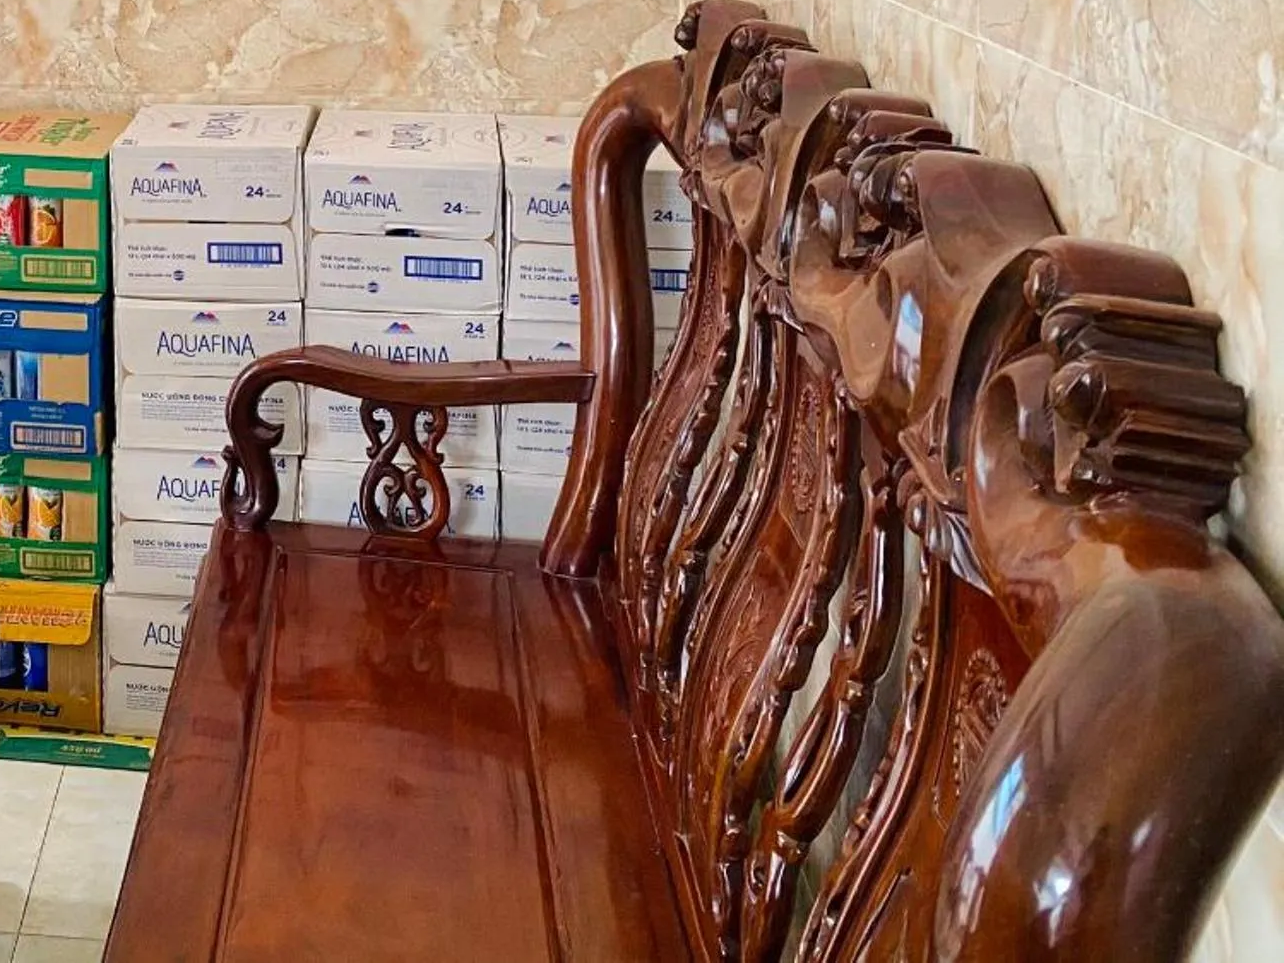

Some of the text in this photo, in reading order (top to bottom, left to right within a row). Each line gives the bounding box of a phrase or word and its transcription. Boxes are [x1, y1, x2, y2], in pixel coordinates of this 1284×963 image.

[130, 176, 204, 197] AQUAFINA
[245, 185, 264, 198] 24
[322, 188, 398, 211] AQUAFINA
[442, 201, 463, 215] 24
[526, 197, 571, 217] AQUA
[652, 209, 673, 222] 24
[267, 310, 286, 322] 24
[465, 322, 484, 334] 24
[156, 330, 257, 359] AQUAFINA
[157, 475, 220, 502] AQUAF
[465, 483, 484, 496] 24
